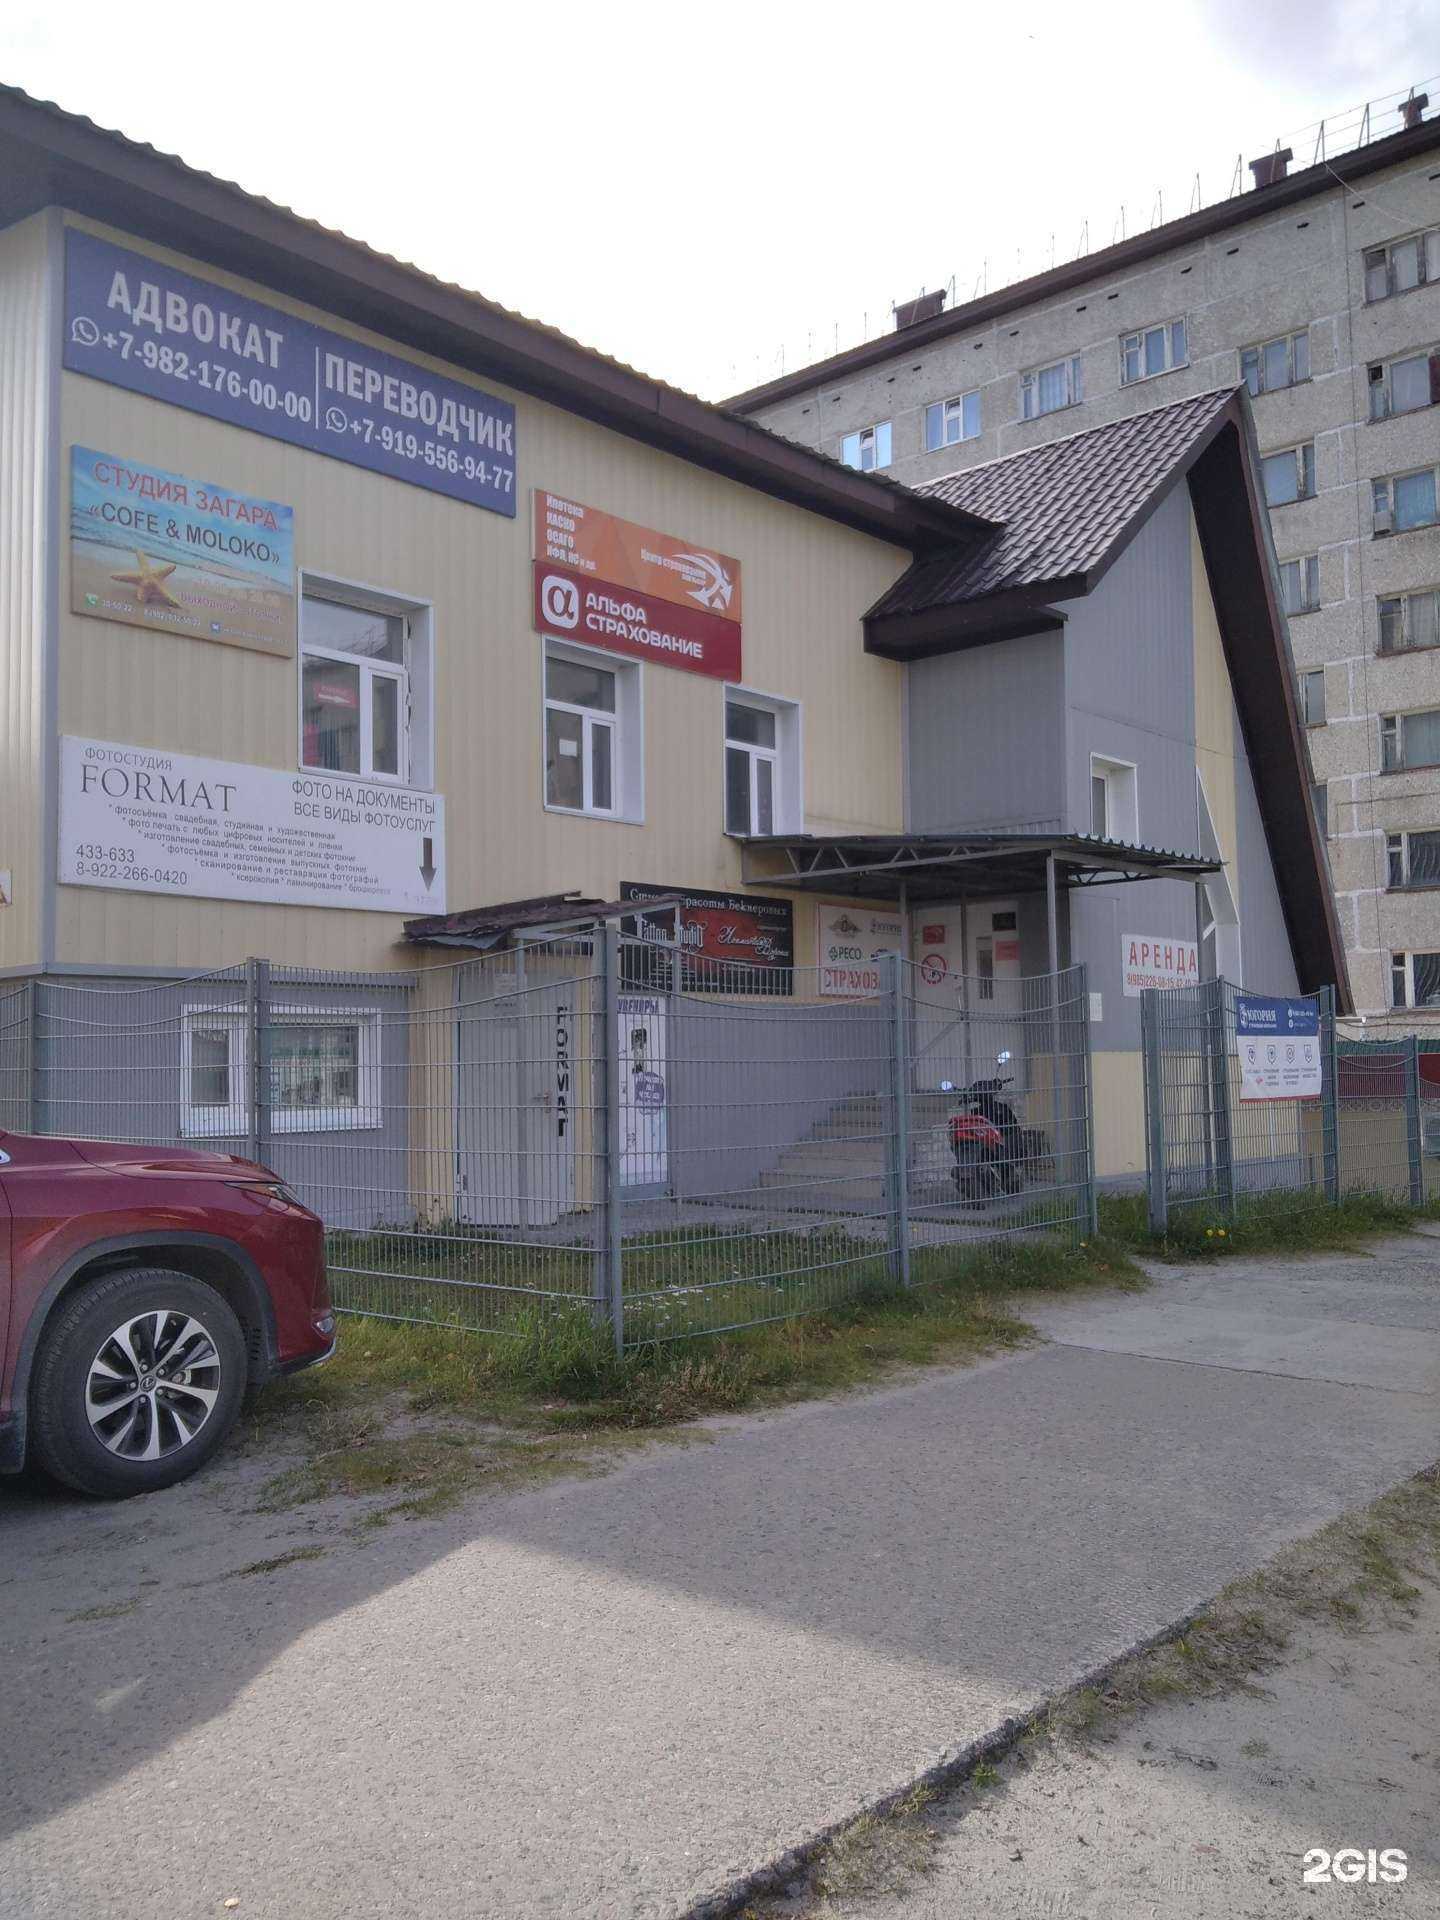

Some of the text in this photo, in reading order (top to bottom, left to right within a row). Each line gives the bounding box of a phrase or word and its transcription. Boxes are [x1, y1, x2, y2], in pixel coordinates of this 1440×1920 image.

[107, 271, 283, 368] АДВОКАТ
[102, 331, 311, 423] +7-982-176-00-00
[325, 353, 514, 456] ПЕРЕВОДЧИК
[350, 419, 513, 492] +7-919-556-94-77
[95, 463, 278, 530] СТУДИЯ ЗАГАРА
[166, 519, 180, 539] &
[186, 524, 280, 565] MOLOKO»
[586, 592, 647, 624] АЛЬФА
[585, 613, 704, 659] СТРАХОВАНИЕ
[85, 747, 173, 770] ФОТОСТУДИЯ
[80, 764, 237, 812] FORMAT
[292, 780, 435, 815] ФОТО НА ДОКУМЕНТЫ
[294, 802, 436, 832] ВСЕ ВИДЫ ФОТОУСЛУГ
[75, 844, 135, 864] 433-633
[75, 861, 188, 885] 8-922-266-0420
[1129, 941, 1197, 976] АРЕНДА
[824, 968, 880, 990] СТРАХОВ
